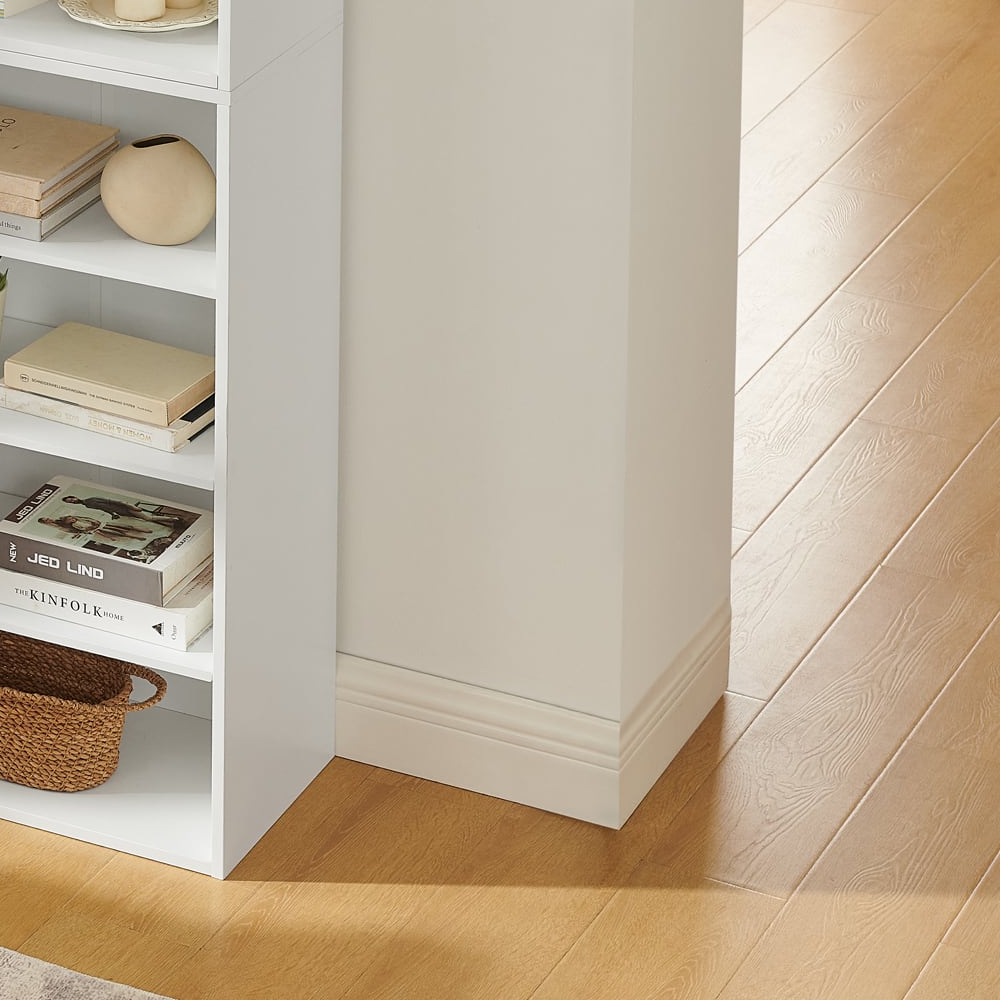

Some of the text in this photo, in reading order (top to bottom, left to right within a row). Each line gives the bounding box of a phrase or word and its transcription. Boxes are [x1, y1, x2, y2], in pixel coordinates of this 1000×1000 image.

[5, 221, 21, 230] things
[16, 489, 53, 520] JED LIND
[27, 553, 103, 580] JED LIND
[14, 588, 124, 621] THE KINFOLK HOME
